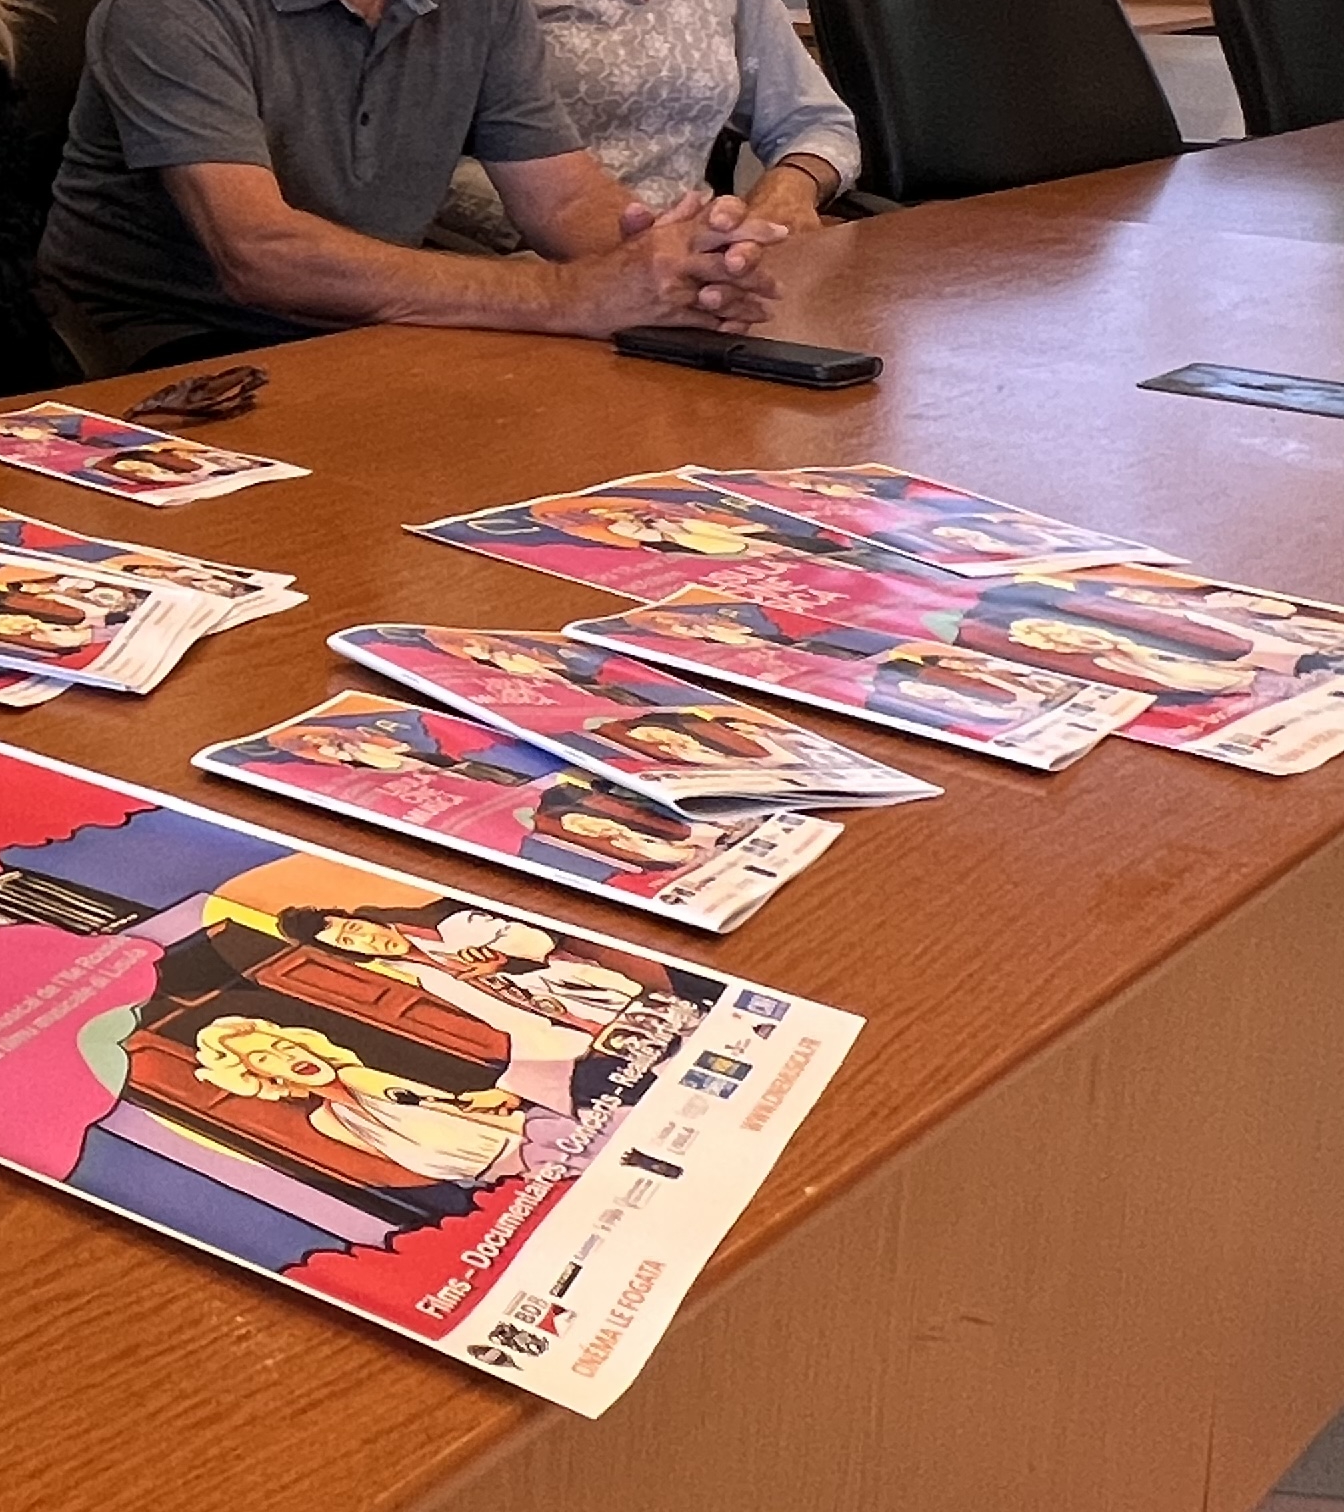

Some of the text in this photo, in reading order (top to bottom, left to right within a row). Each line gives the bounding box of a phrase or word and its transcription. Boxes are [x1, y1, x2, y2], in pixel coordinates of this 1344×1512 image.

[415, 1279, 473, 1320] Films
[460, 1162, 569, 1270] Documentaires
[620, 1259, 667, 1311] FOGATA
